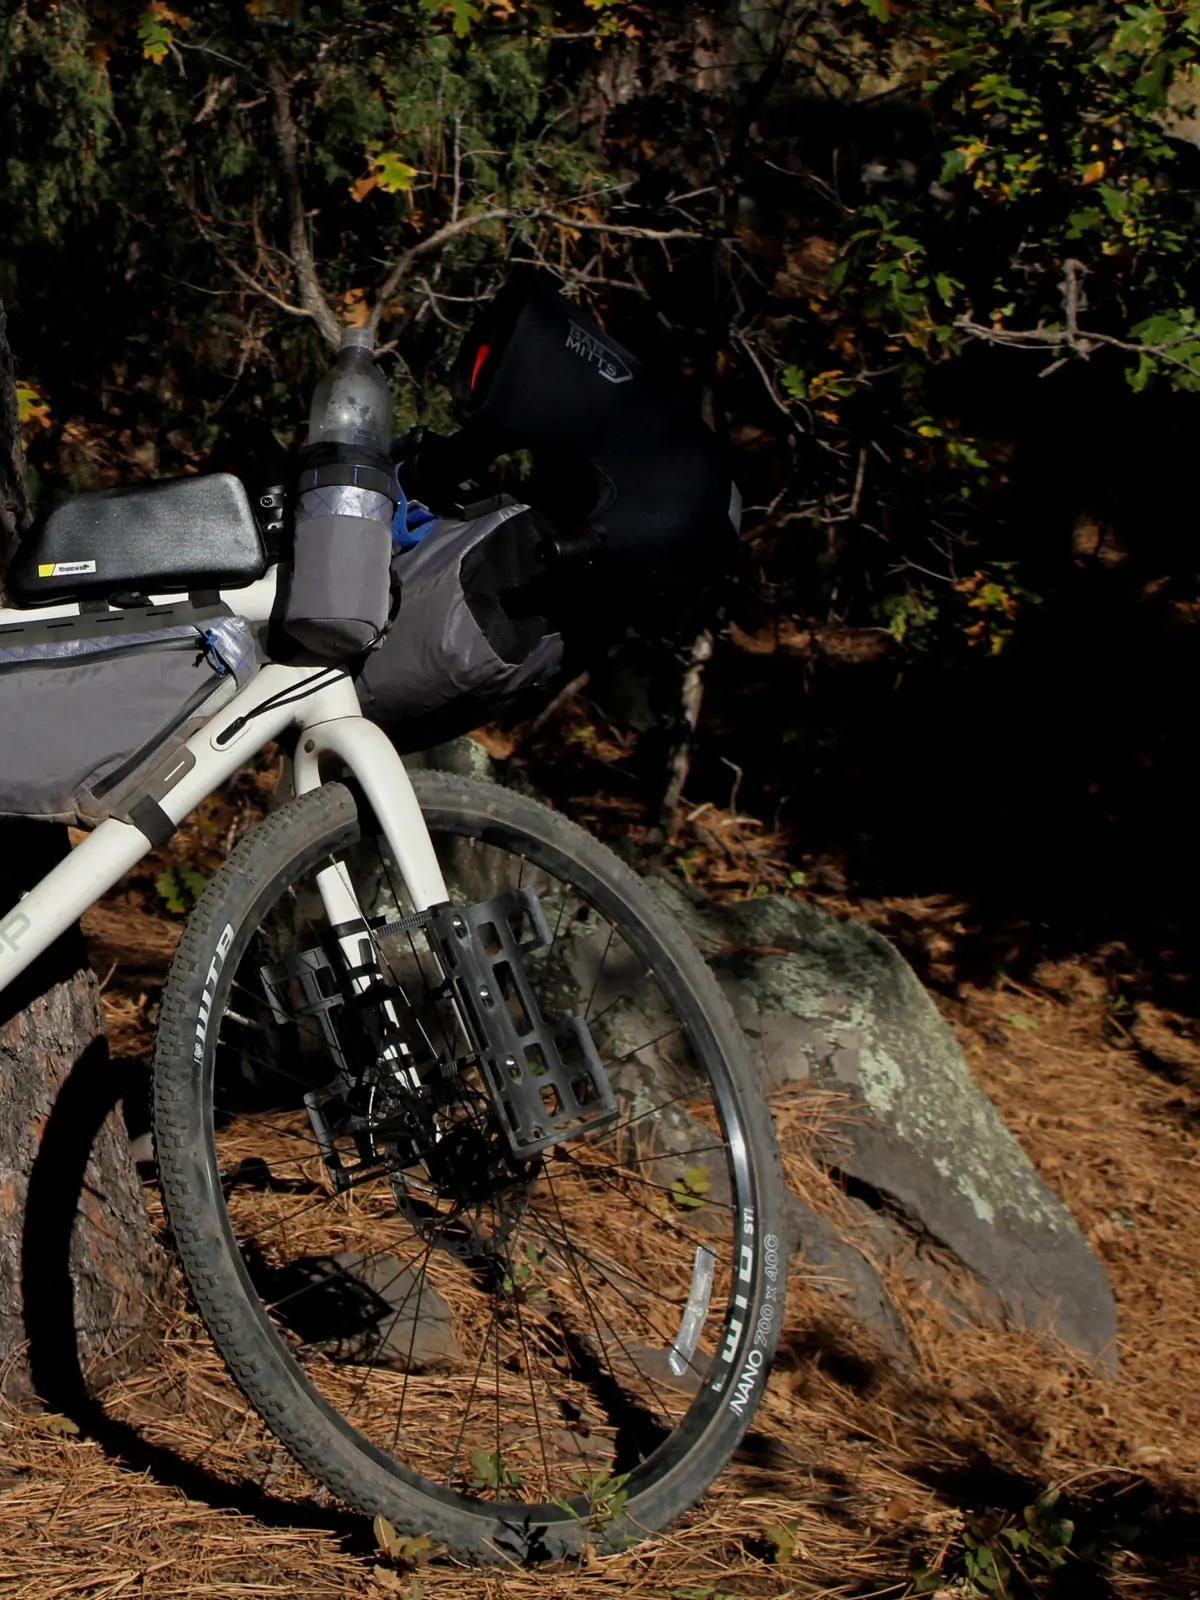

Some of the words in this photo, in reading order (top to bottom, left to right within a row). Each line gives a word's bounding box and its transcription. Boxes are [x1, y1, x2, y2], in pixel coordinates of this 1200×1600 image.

[565, 335, 617, 377] MITTS
[729, 1350, 764, 1416] NANO
[753, 1303, 774, 1347] 700
